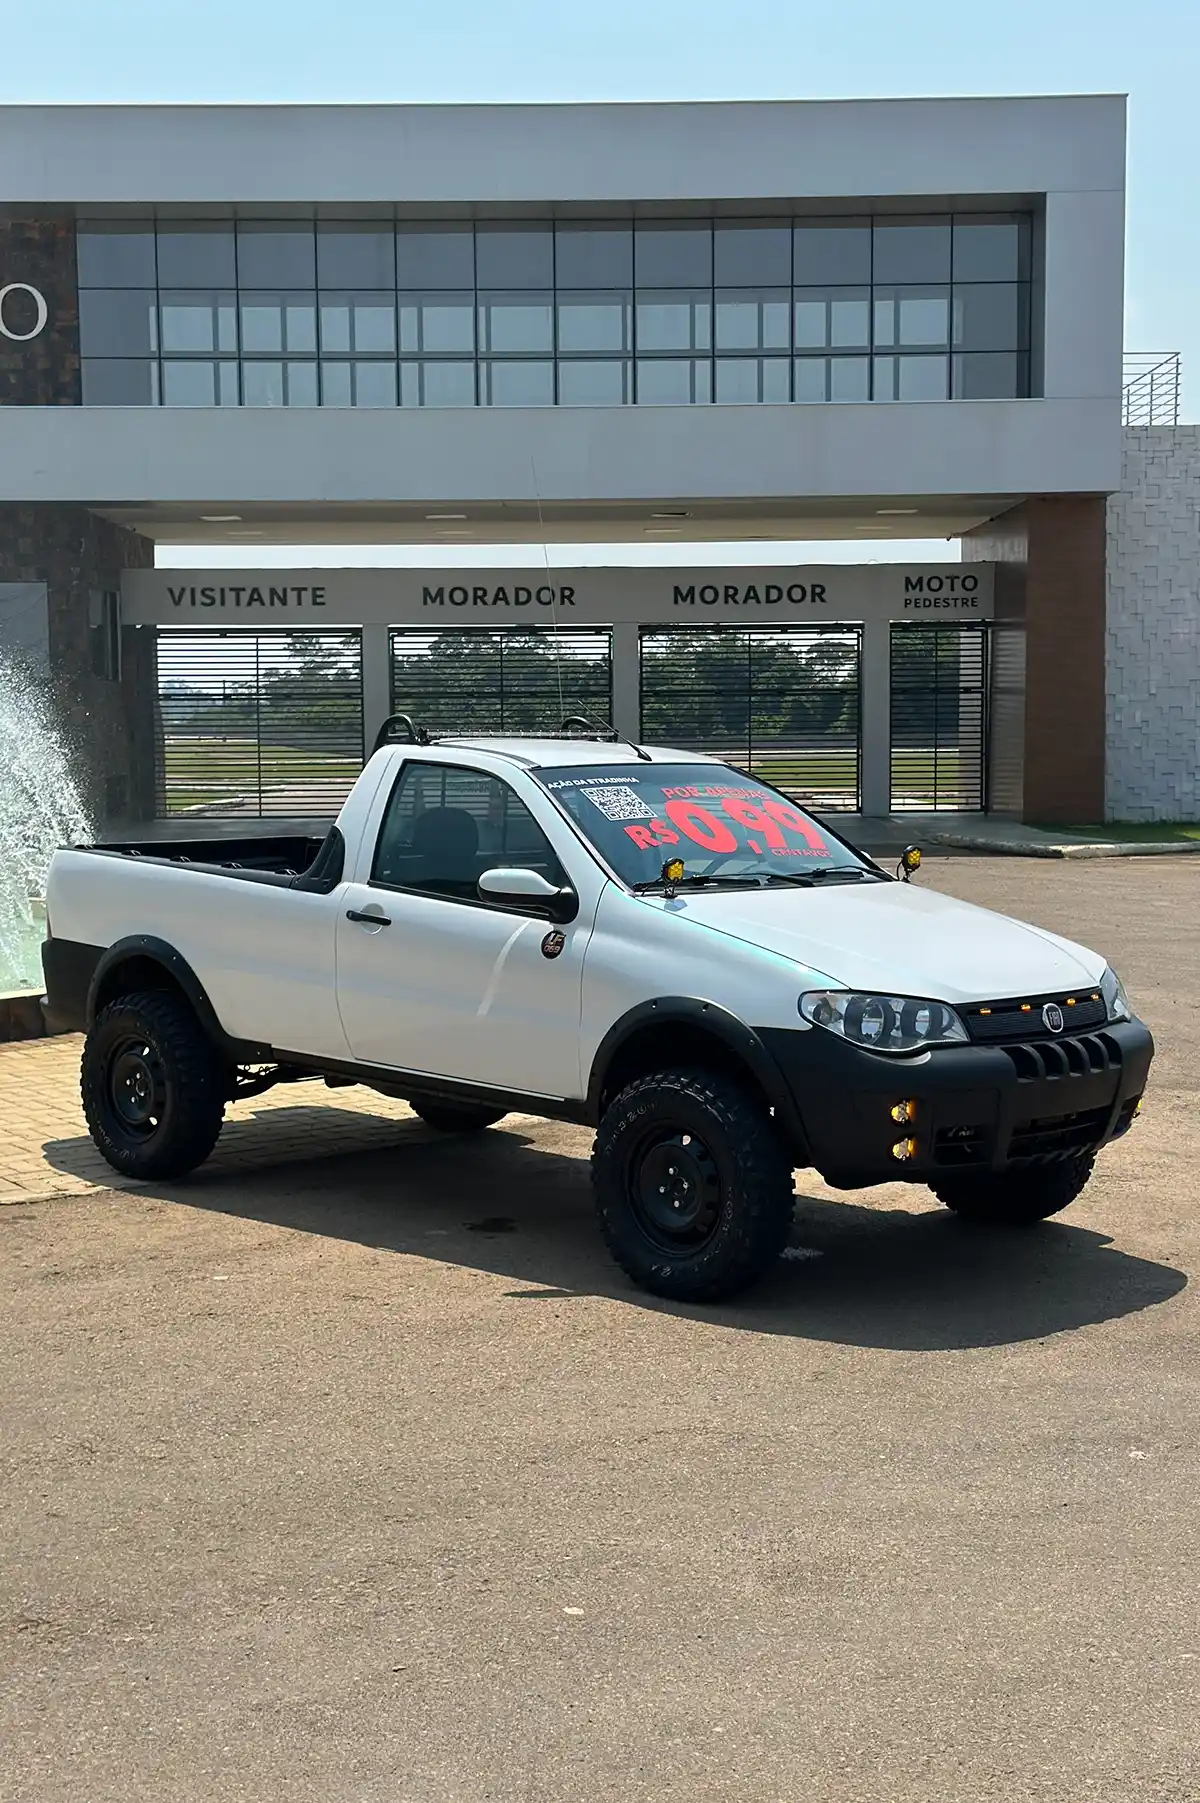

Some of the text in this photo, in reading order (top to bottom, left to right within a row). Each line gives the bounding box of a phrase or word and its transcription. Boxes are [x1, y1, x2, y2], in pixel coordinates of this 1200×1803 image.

[904, 575, 979, 593] MOTO
[167, 586, 327, 607] VISITANTE
[422, 586, 576, 606] MORADOR
[673, 584, 828, 605] MORADOR
[904, 597, 979, 608] PEDESTRE
[547, 779, 573, 789] AÇÃO
[586, 777, 640, 785] STRADINHA
[660, 786, 698, 799] POR
